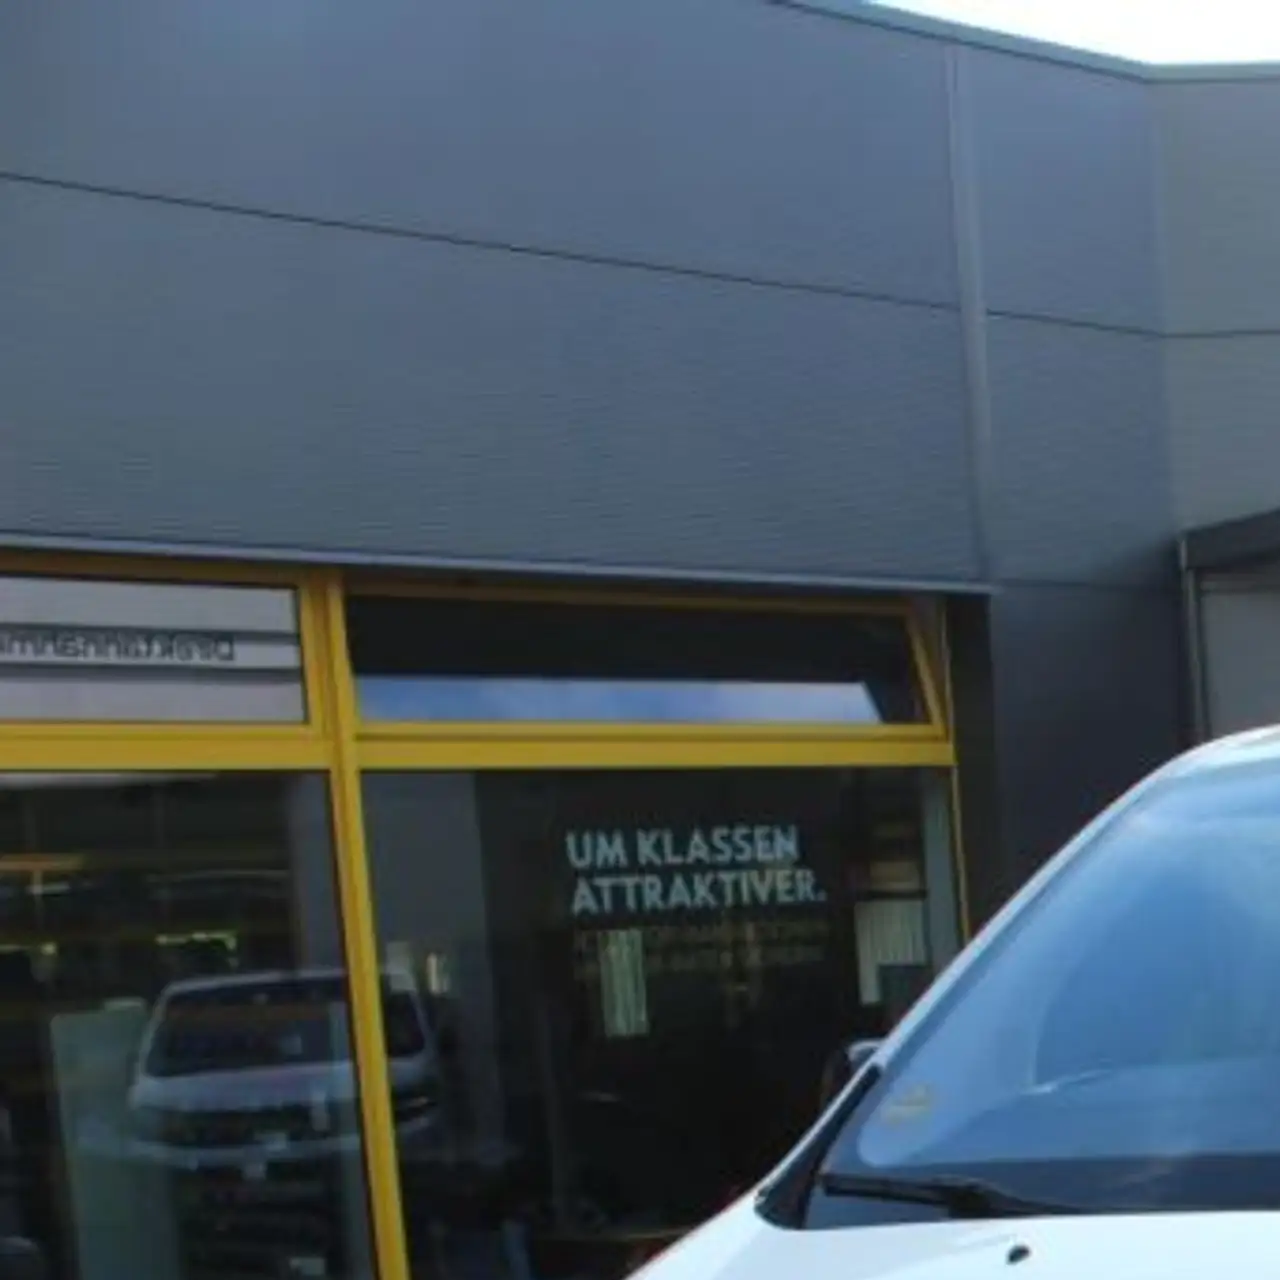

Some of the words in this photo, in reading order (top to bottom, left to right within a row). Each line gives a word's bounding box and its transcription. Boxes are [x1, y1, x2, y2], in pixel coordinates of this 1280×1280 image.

[566, 828, 628, 869] UM
[636, 824, 800, 866] KLASSEN
[572, 868, 828, 916] ATTRAKTIVER.
